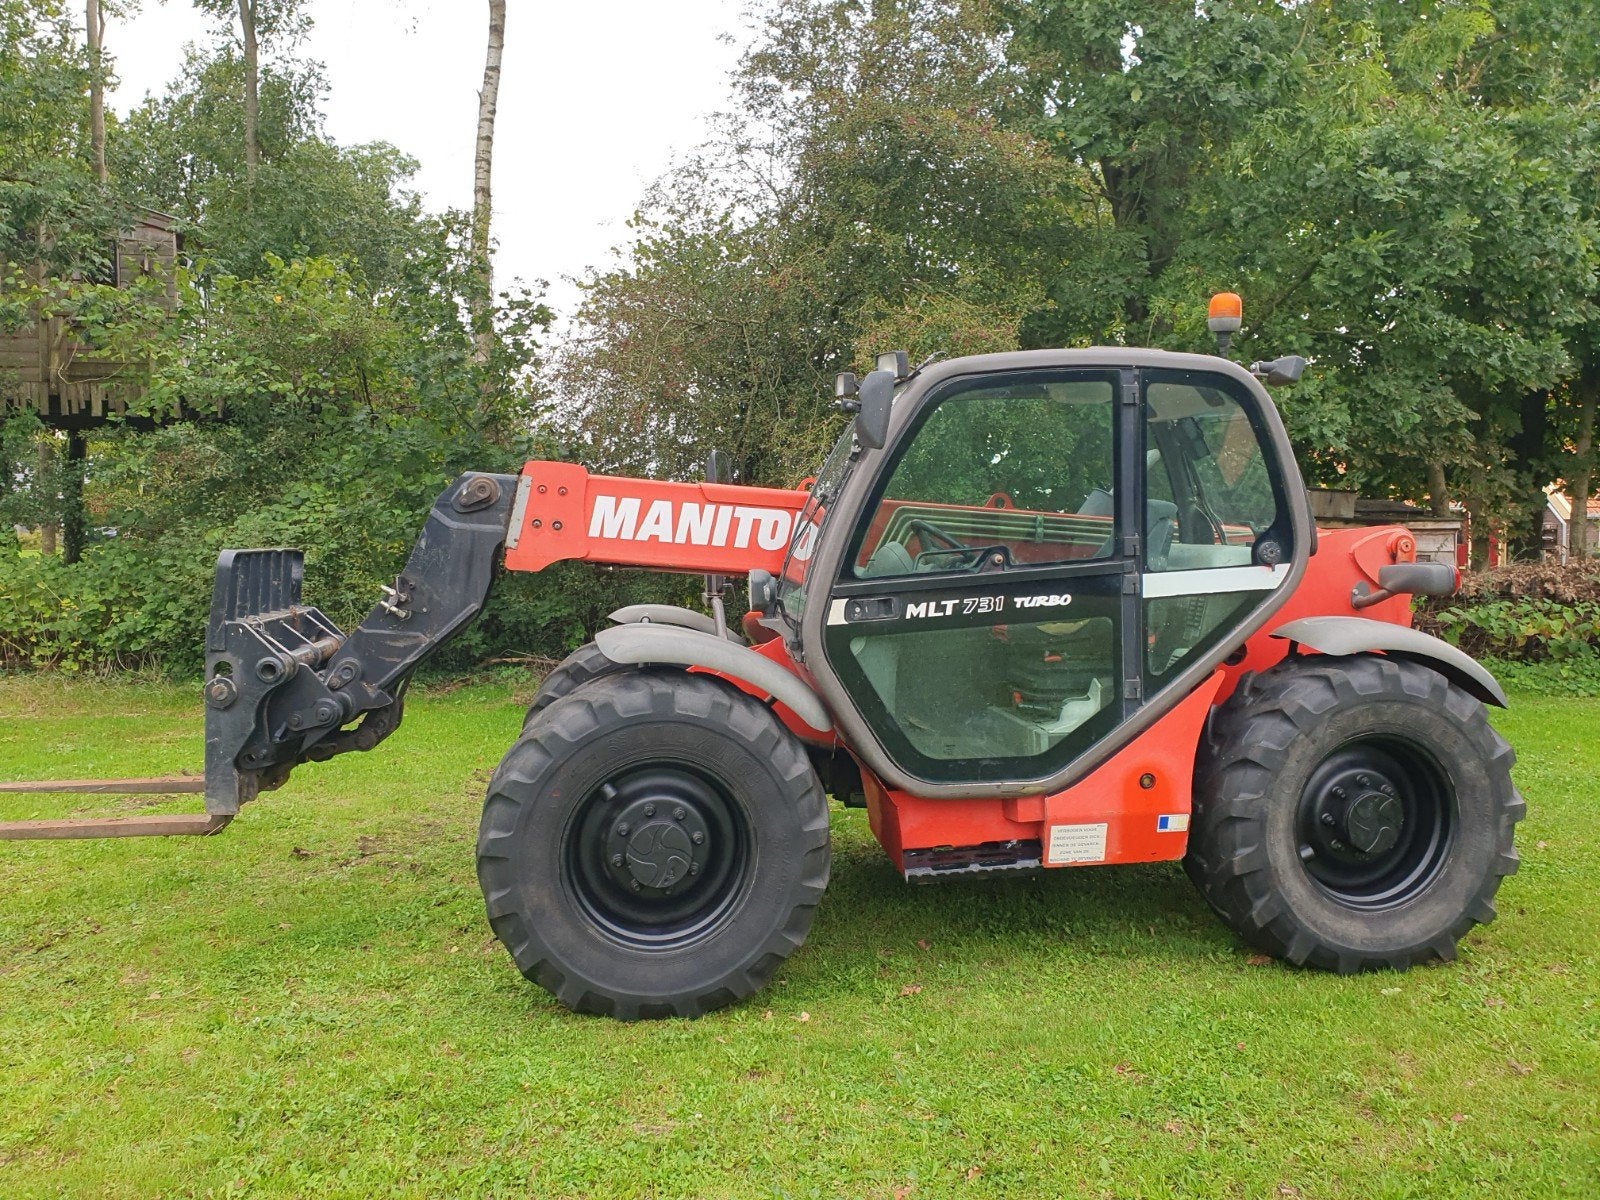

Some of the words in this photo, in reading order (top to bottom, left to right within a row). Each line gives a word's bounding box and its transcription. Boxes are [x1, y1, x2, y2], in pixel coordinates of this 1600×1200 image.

[905, 599, 960, 620] MLT
[962, 595, 1004, 615] 731
[1014, 592, 1072, 609] TURBO
